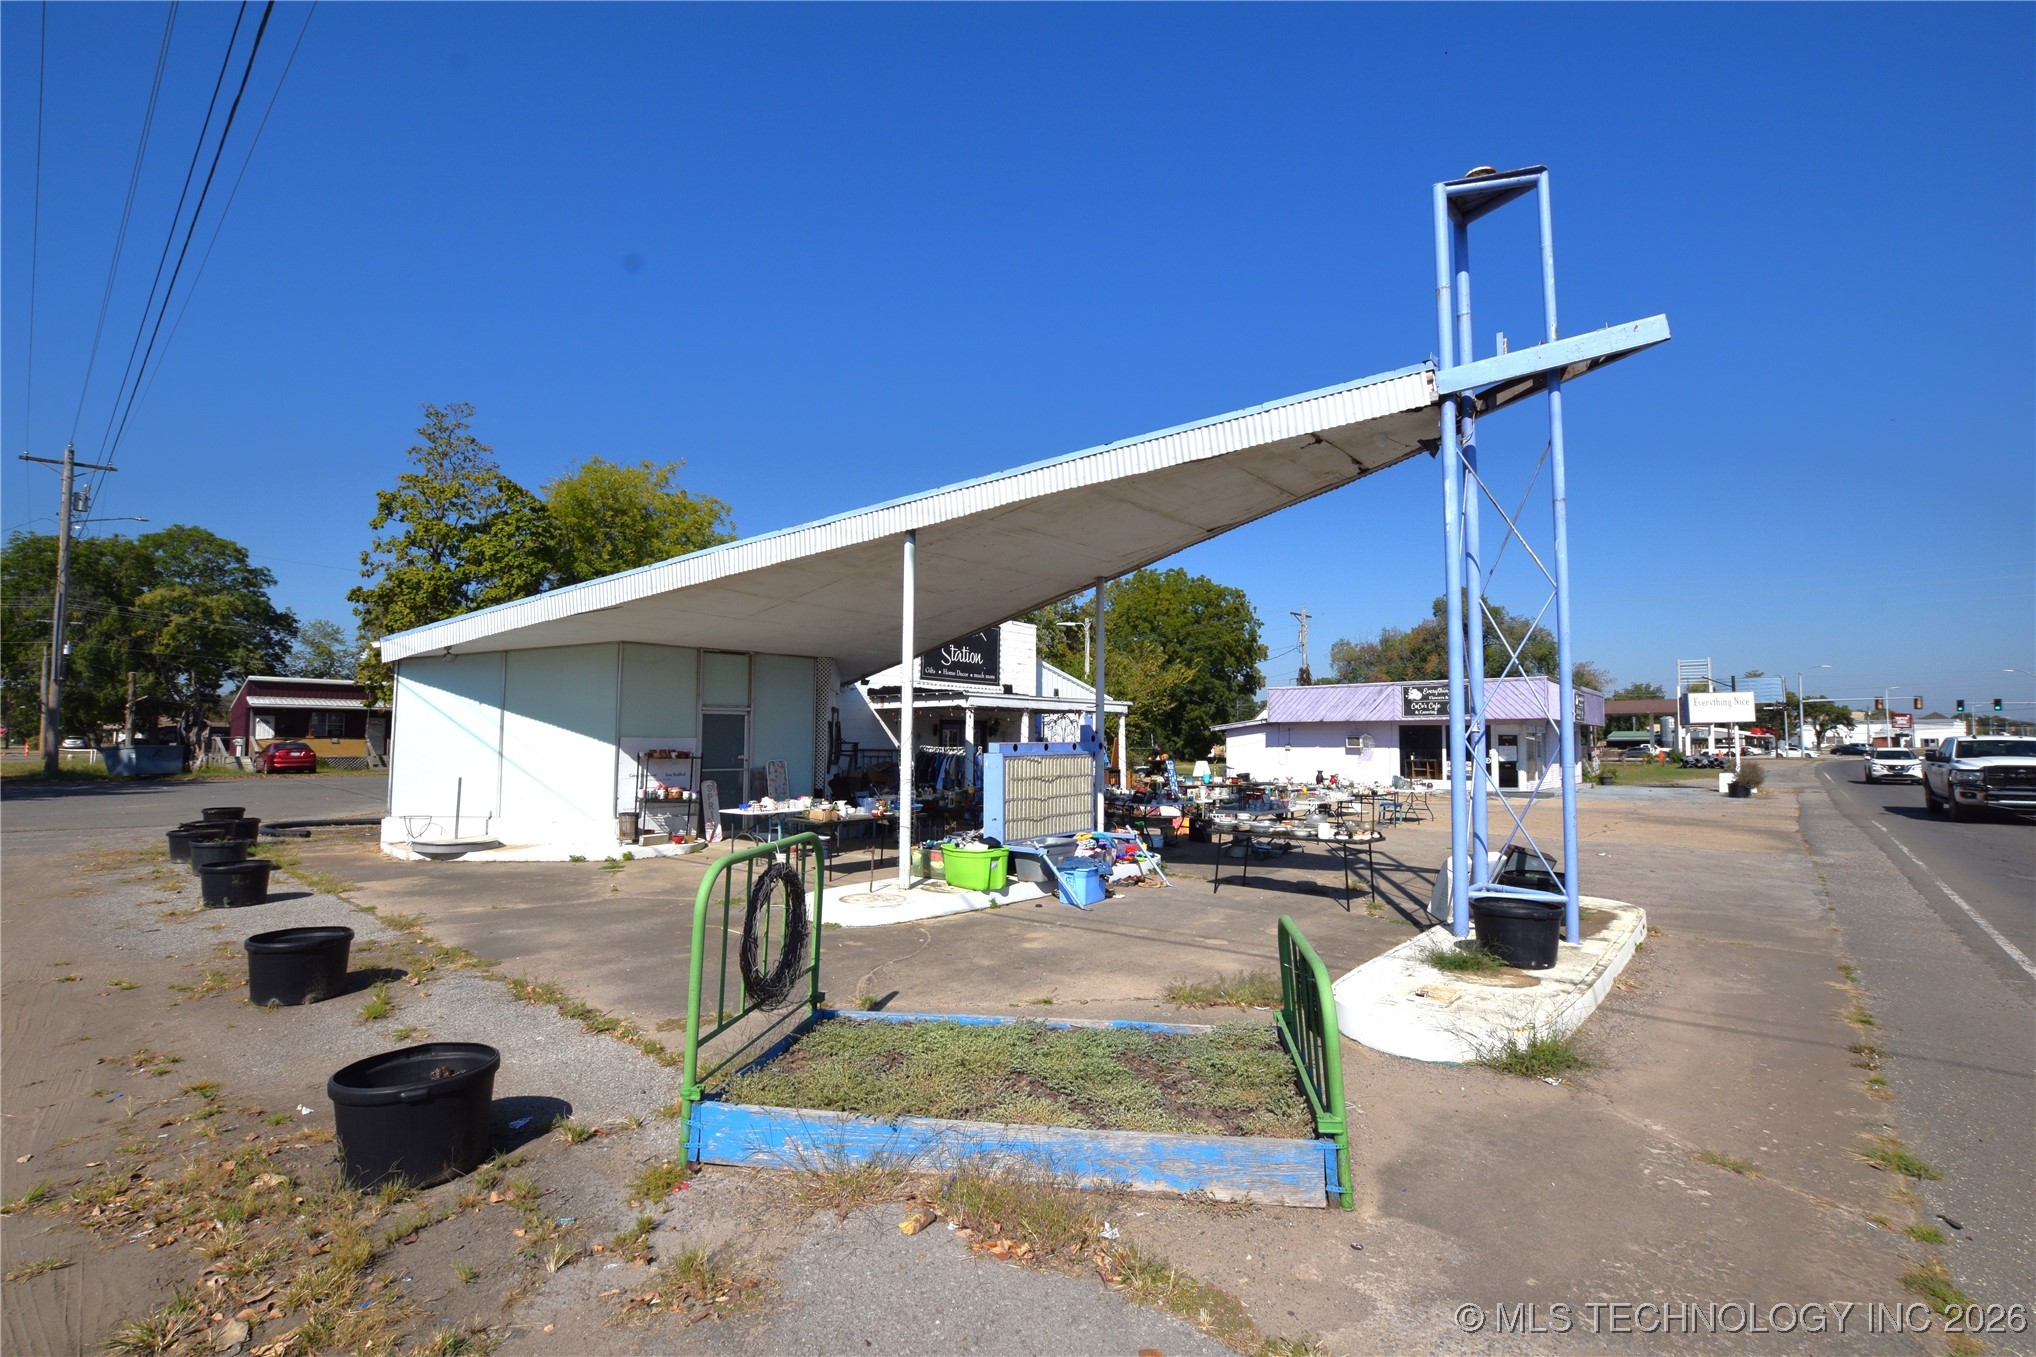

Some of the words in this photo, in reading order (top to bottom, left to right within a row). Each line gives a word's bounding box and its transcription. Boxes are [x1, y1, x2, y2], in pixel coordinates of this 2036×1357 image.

[941, 644, 984, 666] Station
[943, 668, 956, 676] Home
[974, 671, 985, 679] much
[1423, 688, 1449, 696] Everythin
[1693, 697, 1733, 708] Everything
[1734, 696, 1750, 706] Nice
